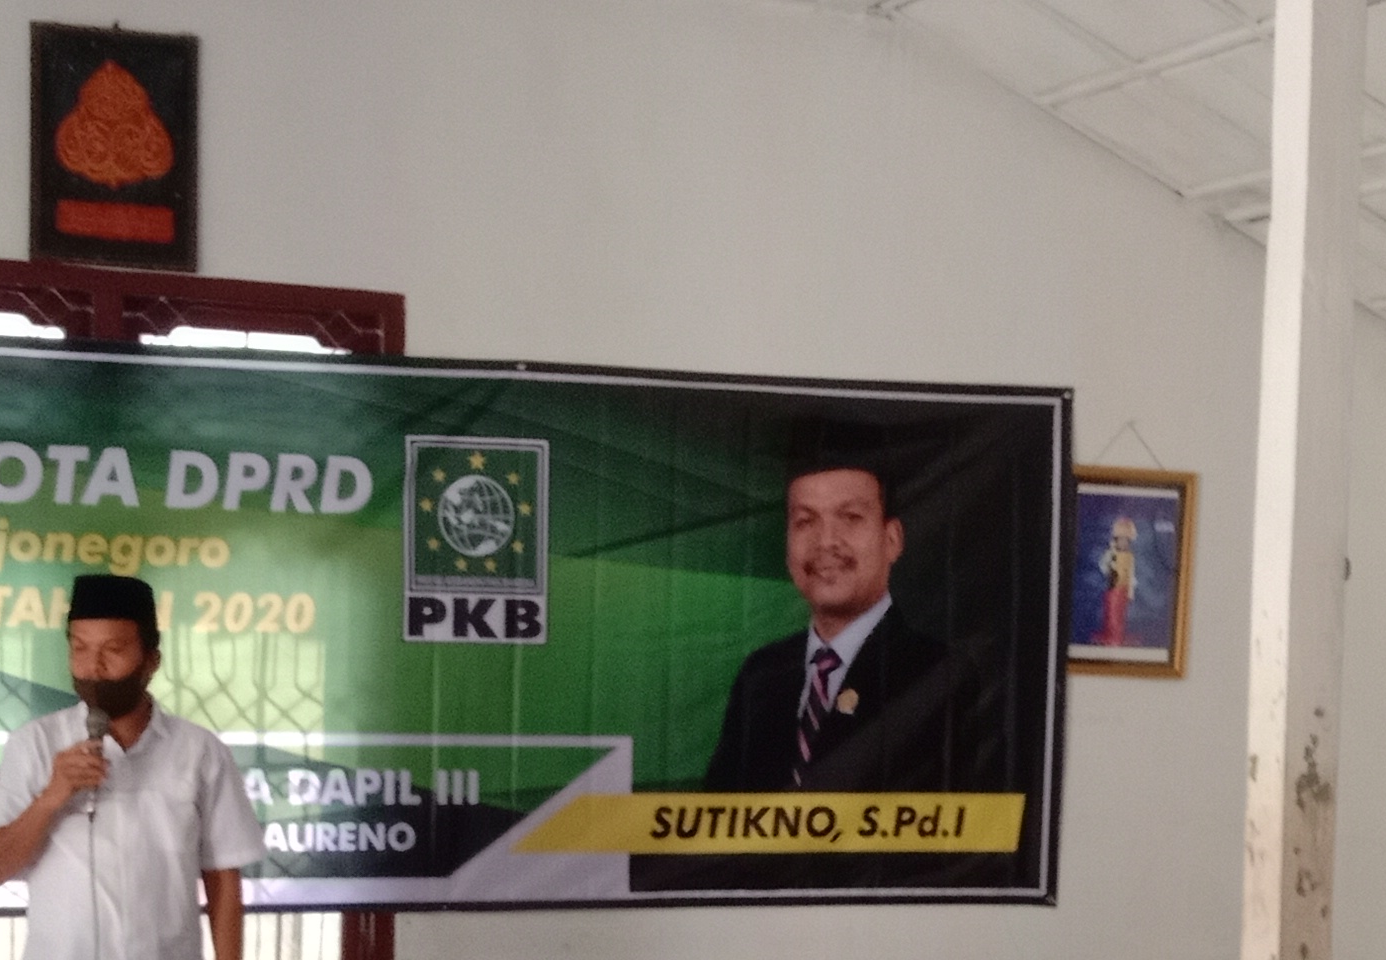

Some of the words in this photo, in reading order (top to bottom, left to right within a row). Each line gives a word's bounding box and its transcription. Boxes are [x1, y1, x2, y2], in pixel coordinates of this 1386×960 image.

[165, 449, 374, 514] DPRD
[193, 591, 317, 633] 2020
[408, 597, 542, 639] PKB
[288, 769, 421, 806] DAPIL
[436, 770, 480, 806] III
[263, 822, 416, 853] AURENO
[651, 806, 842, 842] SUTIKNO,
[858, 805, 964, 839] S.Pd.I
